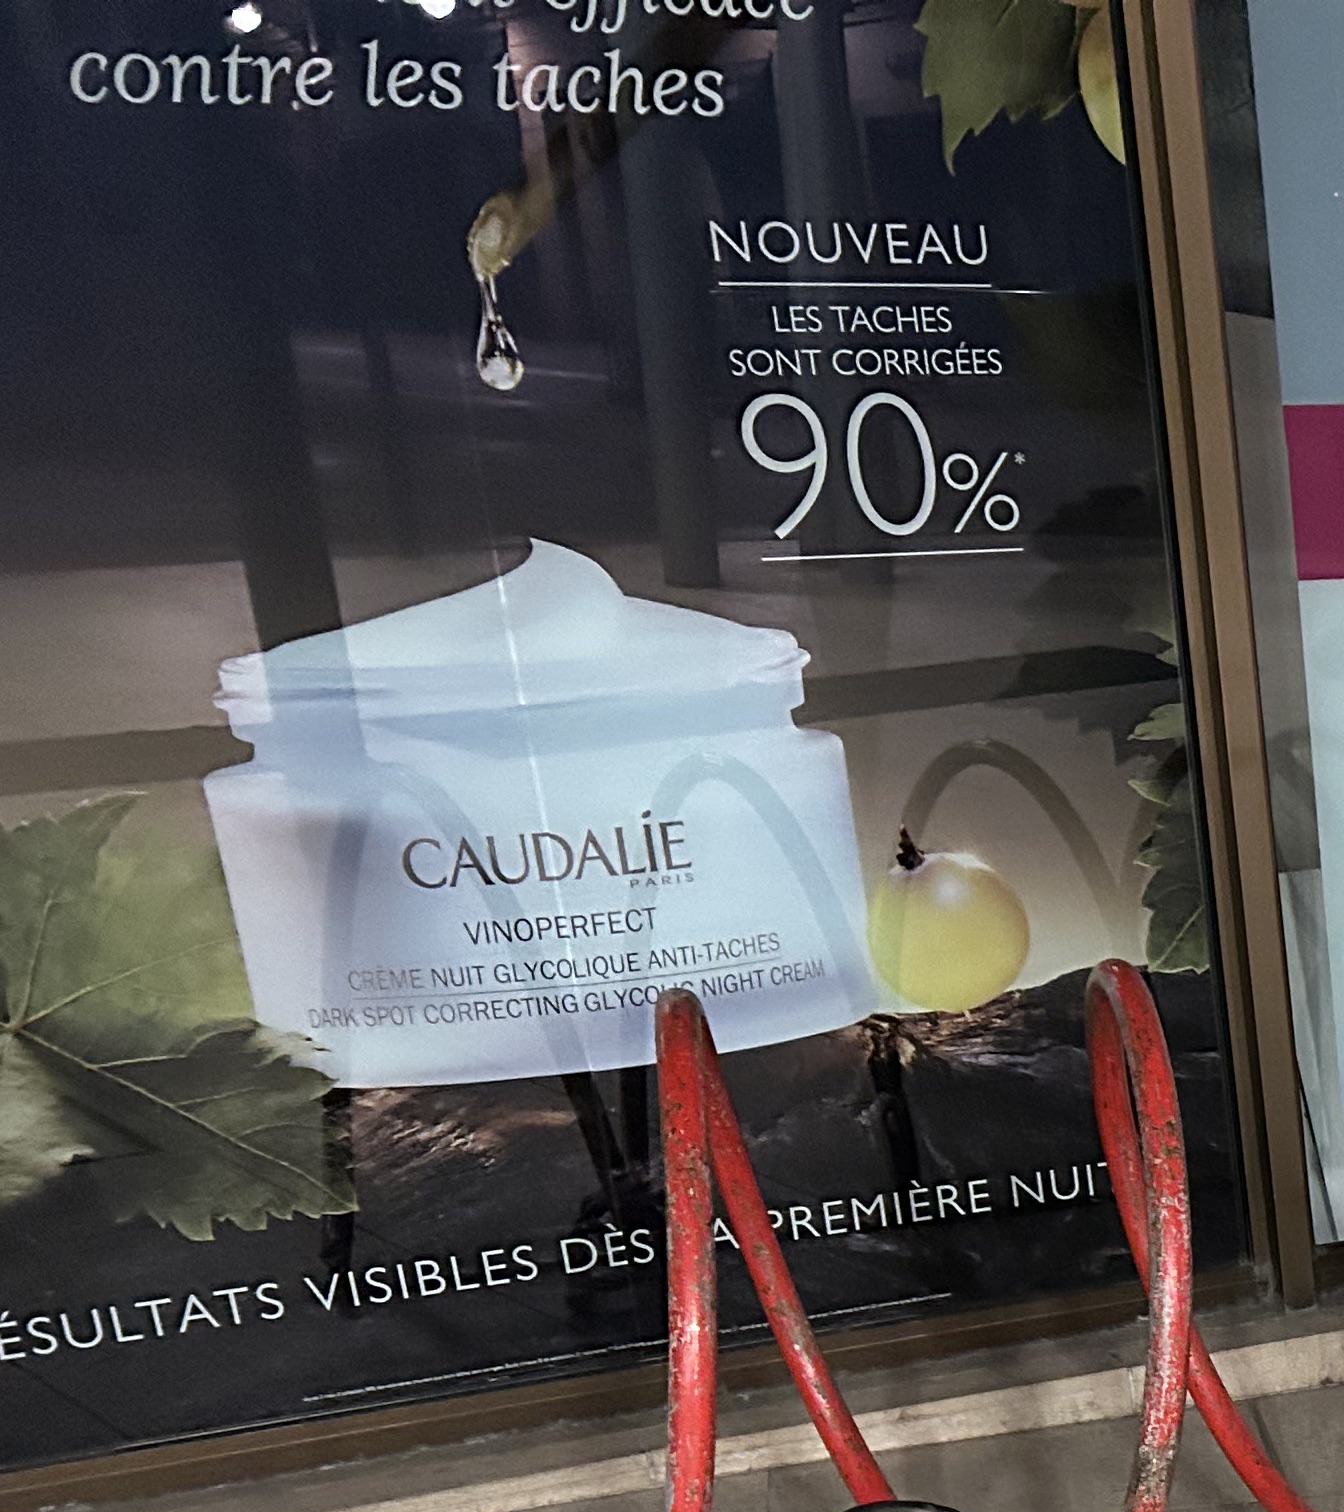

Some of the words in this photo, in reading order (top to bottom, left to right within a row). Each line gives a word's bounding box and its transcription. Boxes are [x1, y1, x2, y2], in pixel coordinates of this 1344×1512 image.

[69, 45, 334, 107] contre
[364, 41, 463, 109] les
[495, 48, 725, 117] taches
[708, 220, 990, 266] NOUVEAU
[771, 306, 822, 333] LES
[829, 306, 952, 334] TACHES
[729, 349, 820, 377] SONT
[832, 342, 1003, 377] CORRIGÉES
[629, 871, 696, 889] PARIS
[463, 907, 657, 946] VINOPERFECT
[431, 964, 486, 988] NUIT
[493, 953, 642, 985] GLYCOLIQUE
[647, 933, 781, 969] ANTI-TACHES
[363, 1002, 417, 1027] SPOT
[423, 989, 579, 1025] CORRECTING
[584, 981, 694, 1013] GLYCO
[702, 969, 763, 999] NIGHT
[304, 1245, 539, 1311] VISIBLES
[559, 1224, 655, 1274] DÈS
